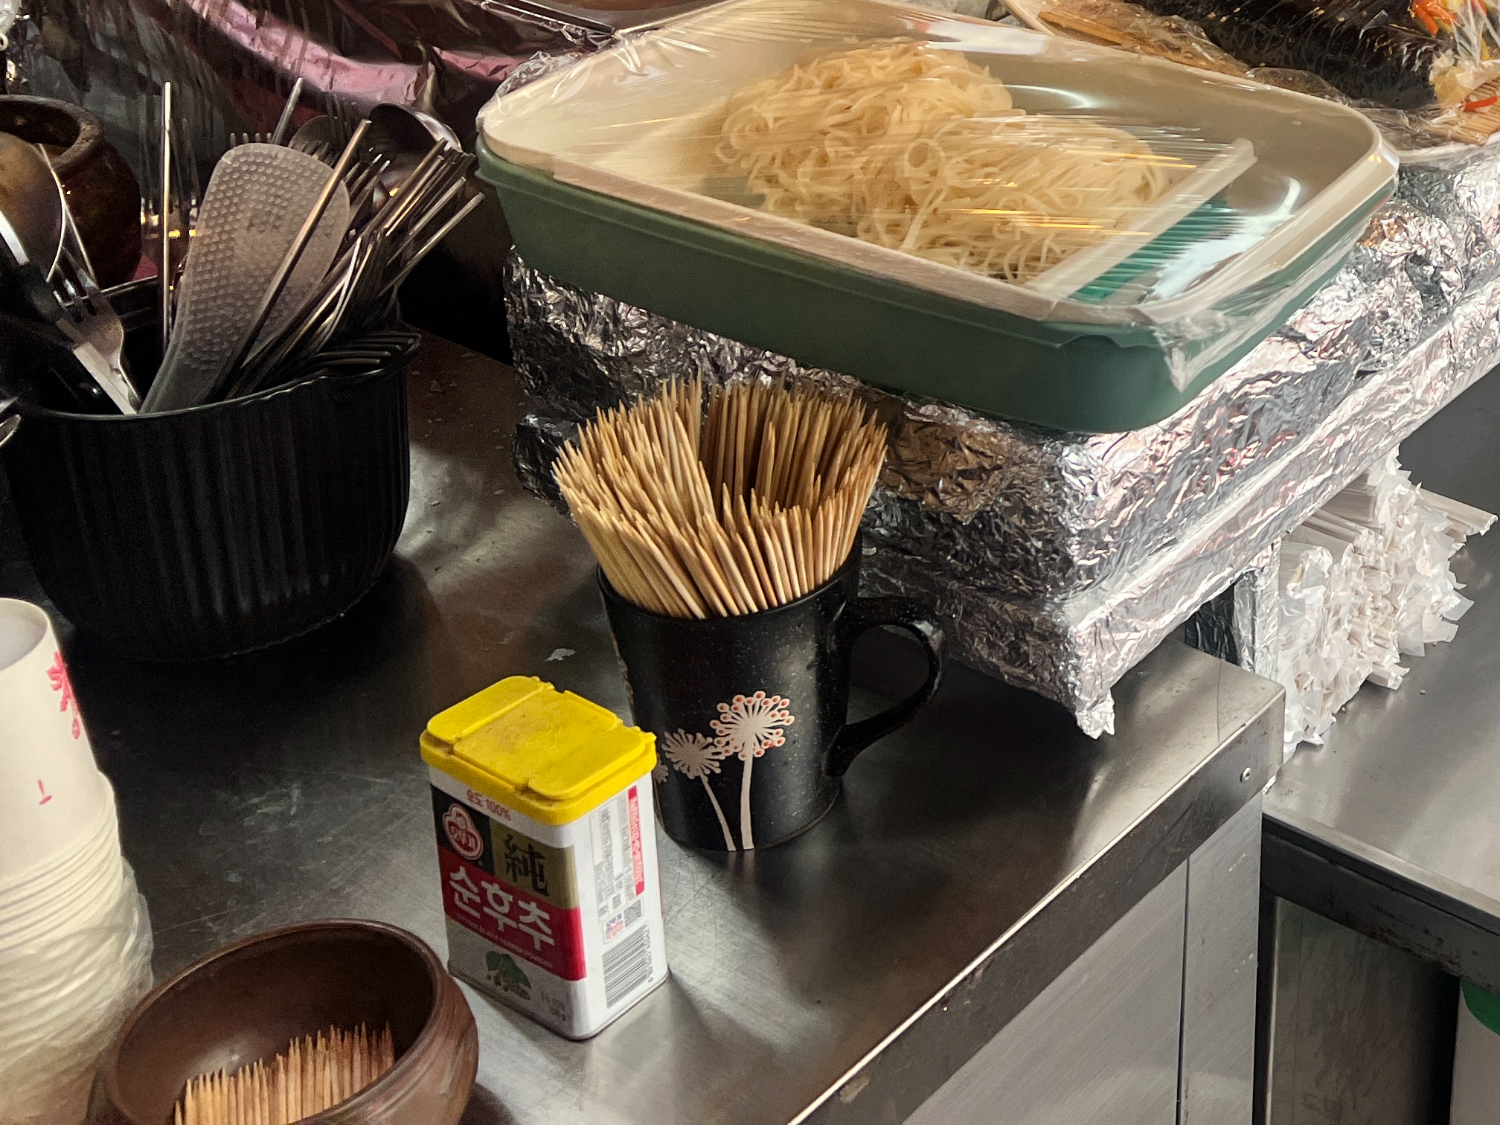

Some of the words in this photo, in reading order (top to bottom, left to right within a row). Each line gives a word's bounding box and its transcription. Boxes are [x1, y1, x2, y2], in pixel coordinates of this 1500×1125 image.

[485, 796, 512, 822] 100%
[503, 833, 550, 898] 純
[449, 865, 556, 951] 순후추
